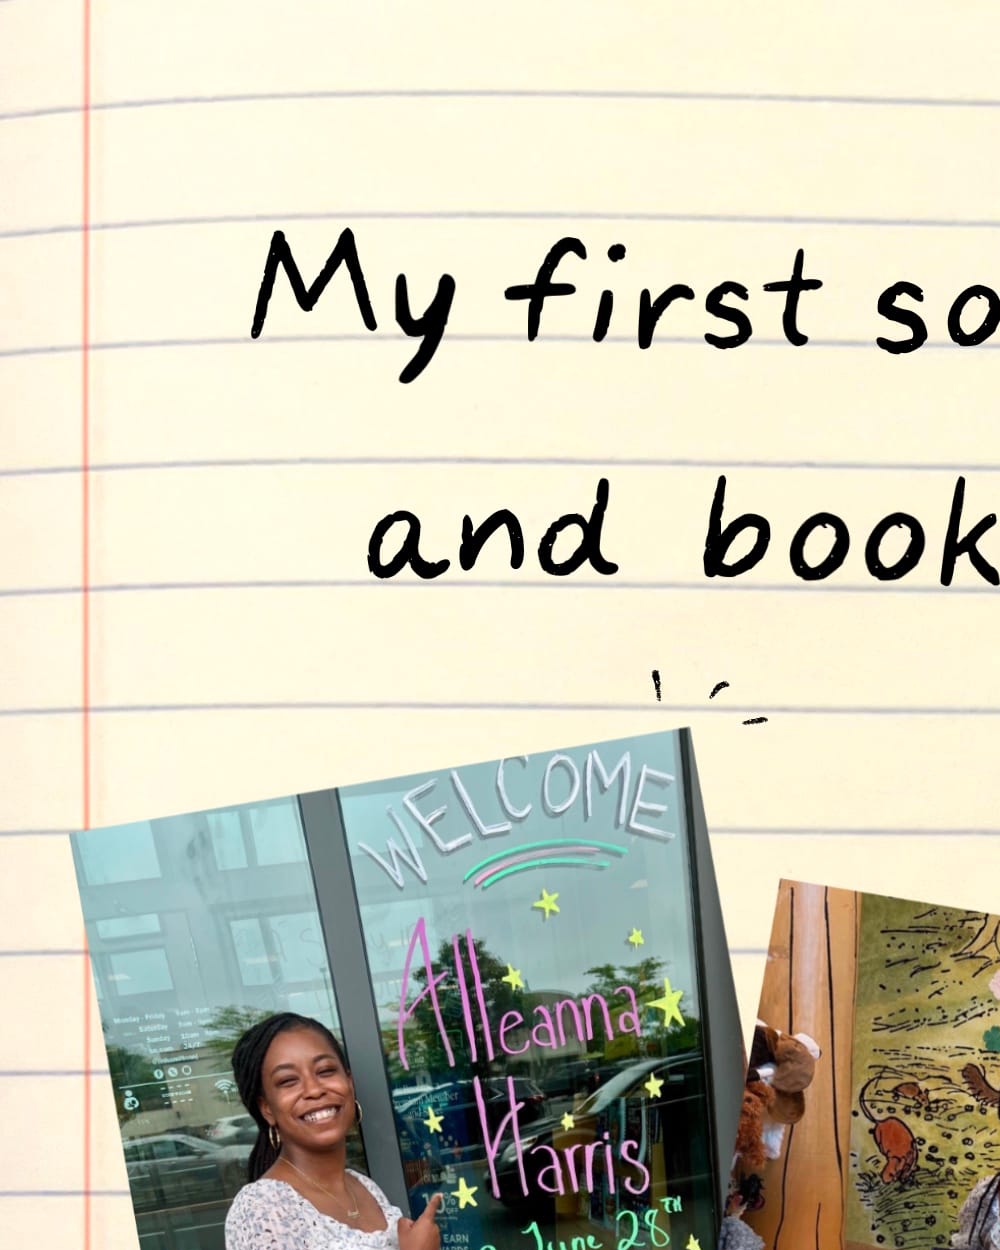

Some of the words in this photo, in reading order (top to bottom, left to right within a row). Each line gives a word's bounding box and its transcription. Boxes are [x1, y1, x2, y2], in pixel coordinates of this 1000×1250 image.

[358, 750, 676, 889] WELCOME
[397, 916, 642, 1071] Alleanna
[474, 1075, 650, 1199] Harris
